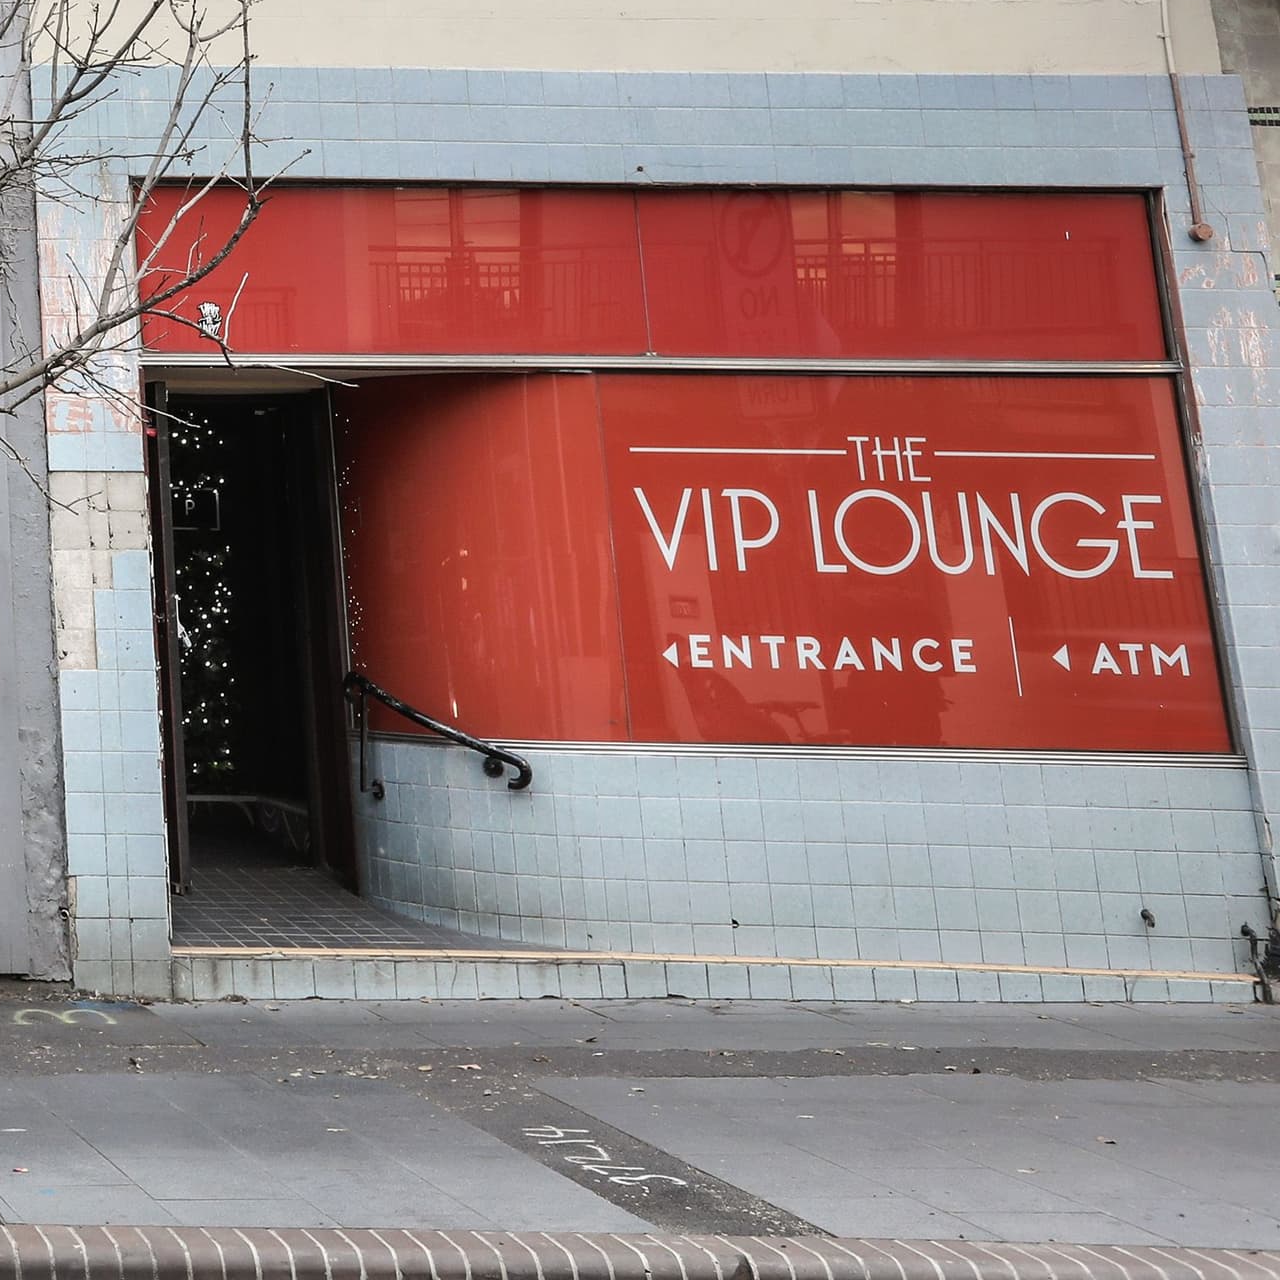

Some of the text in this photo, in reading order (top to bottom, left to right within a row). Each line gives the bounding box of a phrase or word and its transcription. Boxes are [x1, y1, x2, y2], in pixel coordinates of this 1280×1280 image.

[847, 436, 931, 482] THE
[634, 488, 1173, 578] VIP LOUNGE
[689, 634, 1189, 676] ENTRANCE ATM
